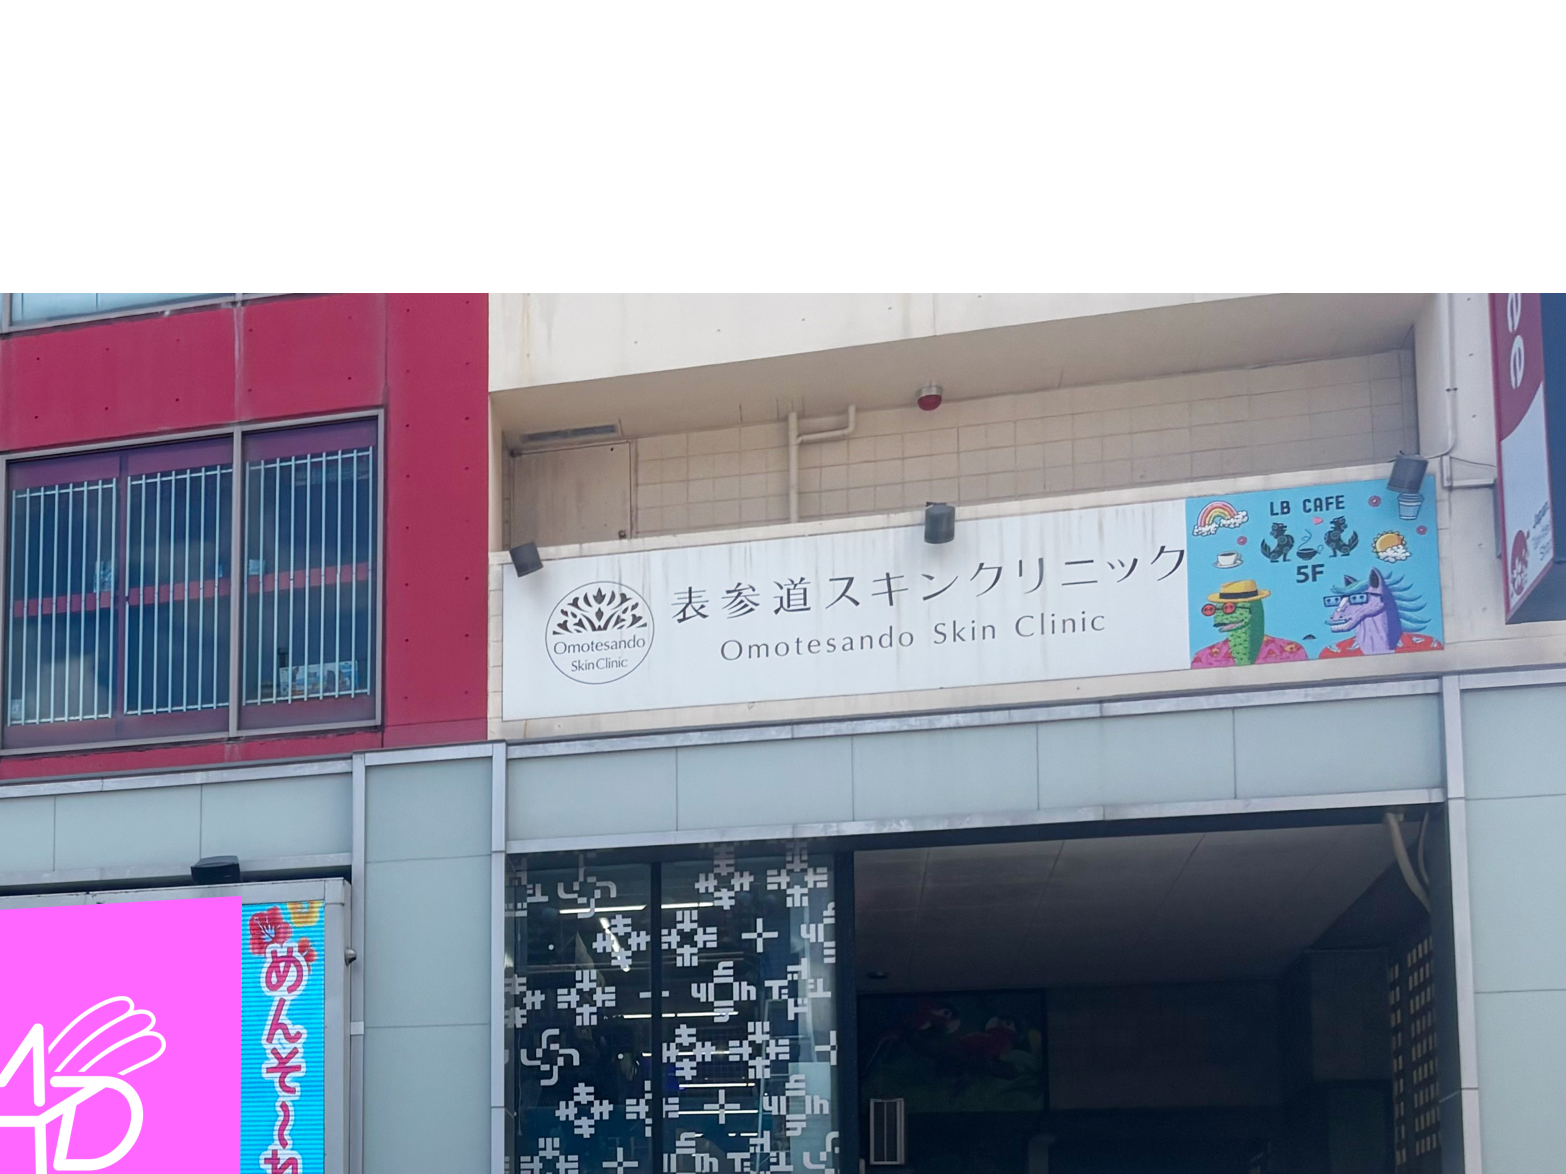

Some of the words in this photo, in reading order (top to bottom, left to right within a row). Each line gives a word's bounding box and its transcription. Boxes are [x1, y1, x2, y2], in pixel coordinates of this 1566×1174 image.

[1269, 500, 1291, 516] LB
[1302, 494, 1346, 514] CAFE
[670, 544, 1185, 625] 表参道スキンクリニック
[1295, 563, 1325, 584] 5F
[552, 634, 646, 656] Omotesando
[720, 624, 915, 662] Omotesando
[933, 619, 997, 645] Skin
[1014, 610, 1106, 638] Clinic
[570, 656, 595, 672] Skin
[595, 656, 629, 671] Clinic
